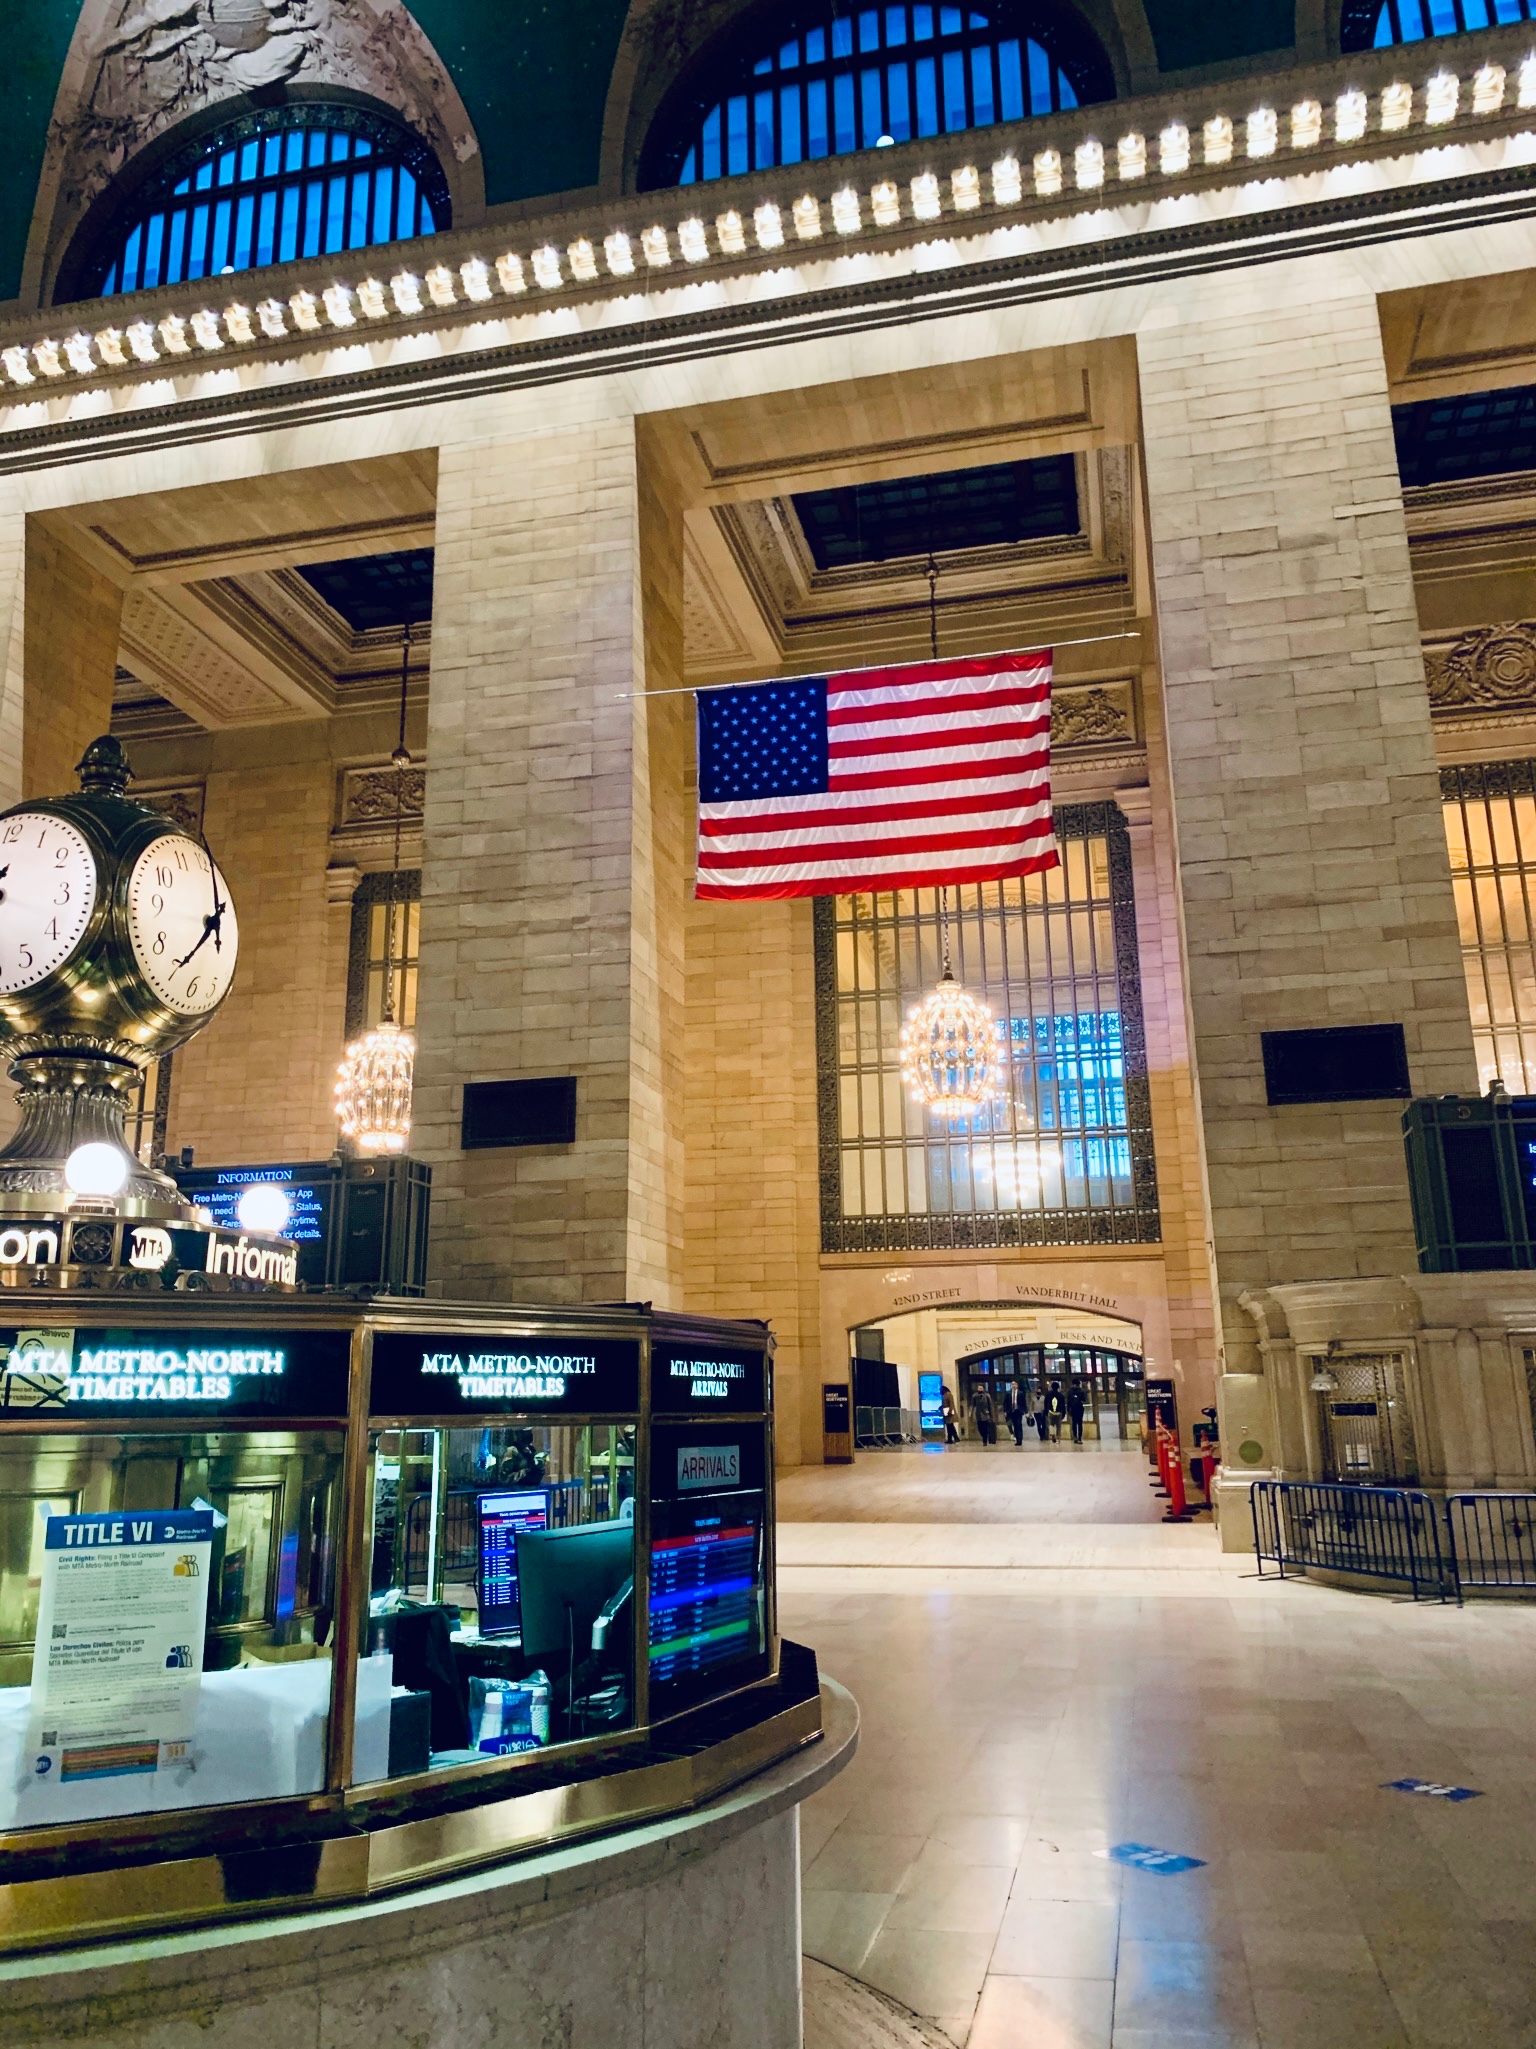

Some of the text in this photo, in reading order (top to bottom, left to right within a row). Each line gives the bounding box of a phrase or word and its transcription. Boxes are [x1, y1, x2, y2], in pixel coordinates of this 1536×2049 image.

[1, 823, 23, 844] 12
[37, 829, 47, 849] 1
[53, 847, 69, 869] 2
[174, 850, 190, 872] 11
[194, 851, 210, 873] 12
[155, 865, 174, 888] 10
[53, 881, 71, 906] 3
[151, 893, 164, 918] 9
[44, 916, 61, 941] 4
[152, 931, 167, 955] 8
[18, 943, 33, 969] 5
[186, 975, 201, 998] 6
[217, 1170, 292, 1184] INFORMATION
[193, 1194, 210, 1203] Free
[297, 1189, 313, 1199] App
[214, 1207, 233, 1216] need
[296, 1202, 323, 1211] Status,
[283, 1230, 293, 1238] for
[294, 1230, 321, 1239] details.
[892, 1288, 961, 1306] 42ND STREET
[1015, 1285, 1118, 1309] VANDERBILT HALL
[964, 1333, 1025, 1352] 42ND STREET
[1060, 1331, 1087, 1341] BUSES
[1090, 1334, 1113, 1345] AND
[6, 1348, 284, 1374] MTA METRO-NORTH
[421, 1353, 596, 1374] MTA METRO-NORTH
[670, 1360, 745, 1378] MTA METRO-NORTH
[64, 1376, 232, 1400] TIMETABLES
[458, 1376, 565, 1397] TIMETABLES
[690, 1380, 728, 1397] ARRIVALS
[681, 1455, 737, 1481] ARRIVALS
[64, 1522, 124, 1545] TITLE
[131, 1521, 152, 1542] VI
